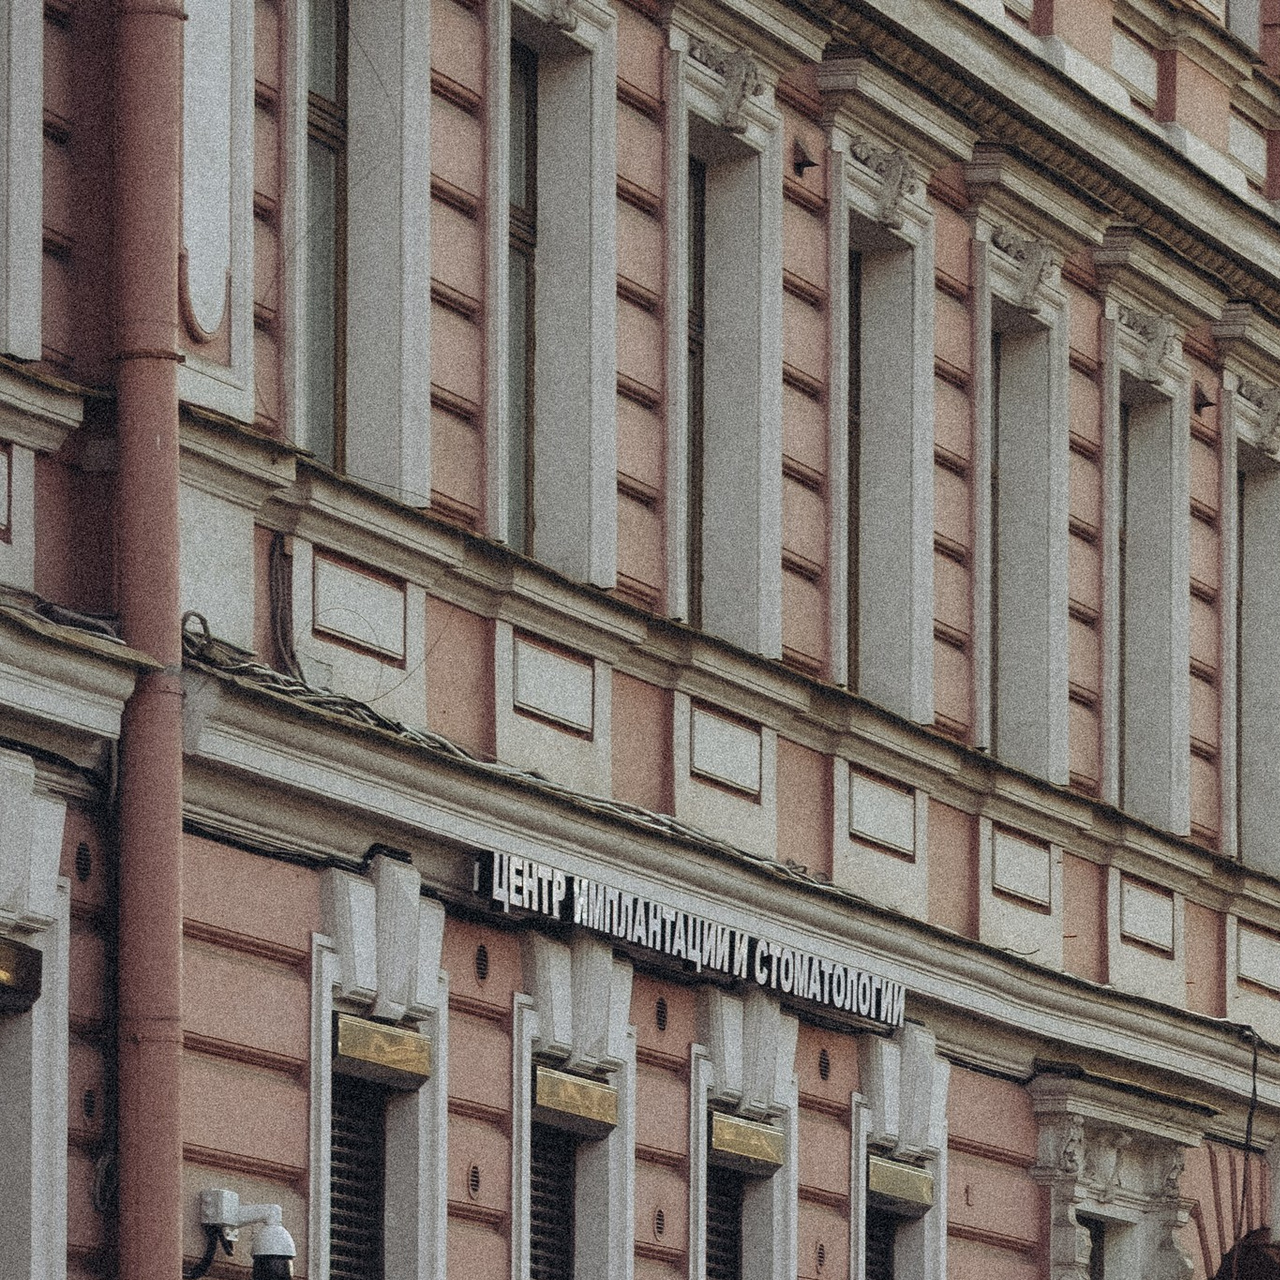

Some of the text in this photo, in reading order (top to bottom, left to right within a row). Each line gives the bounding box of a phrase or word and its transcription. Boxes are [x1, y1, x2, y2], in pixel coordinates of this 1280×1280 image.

[492, 853, 906, 1028] ЦЕНТР ИМПЛАНТАЦИИ И СТОМАТОЛОГИИ
